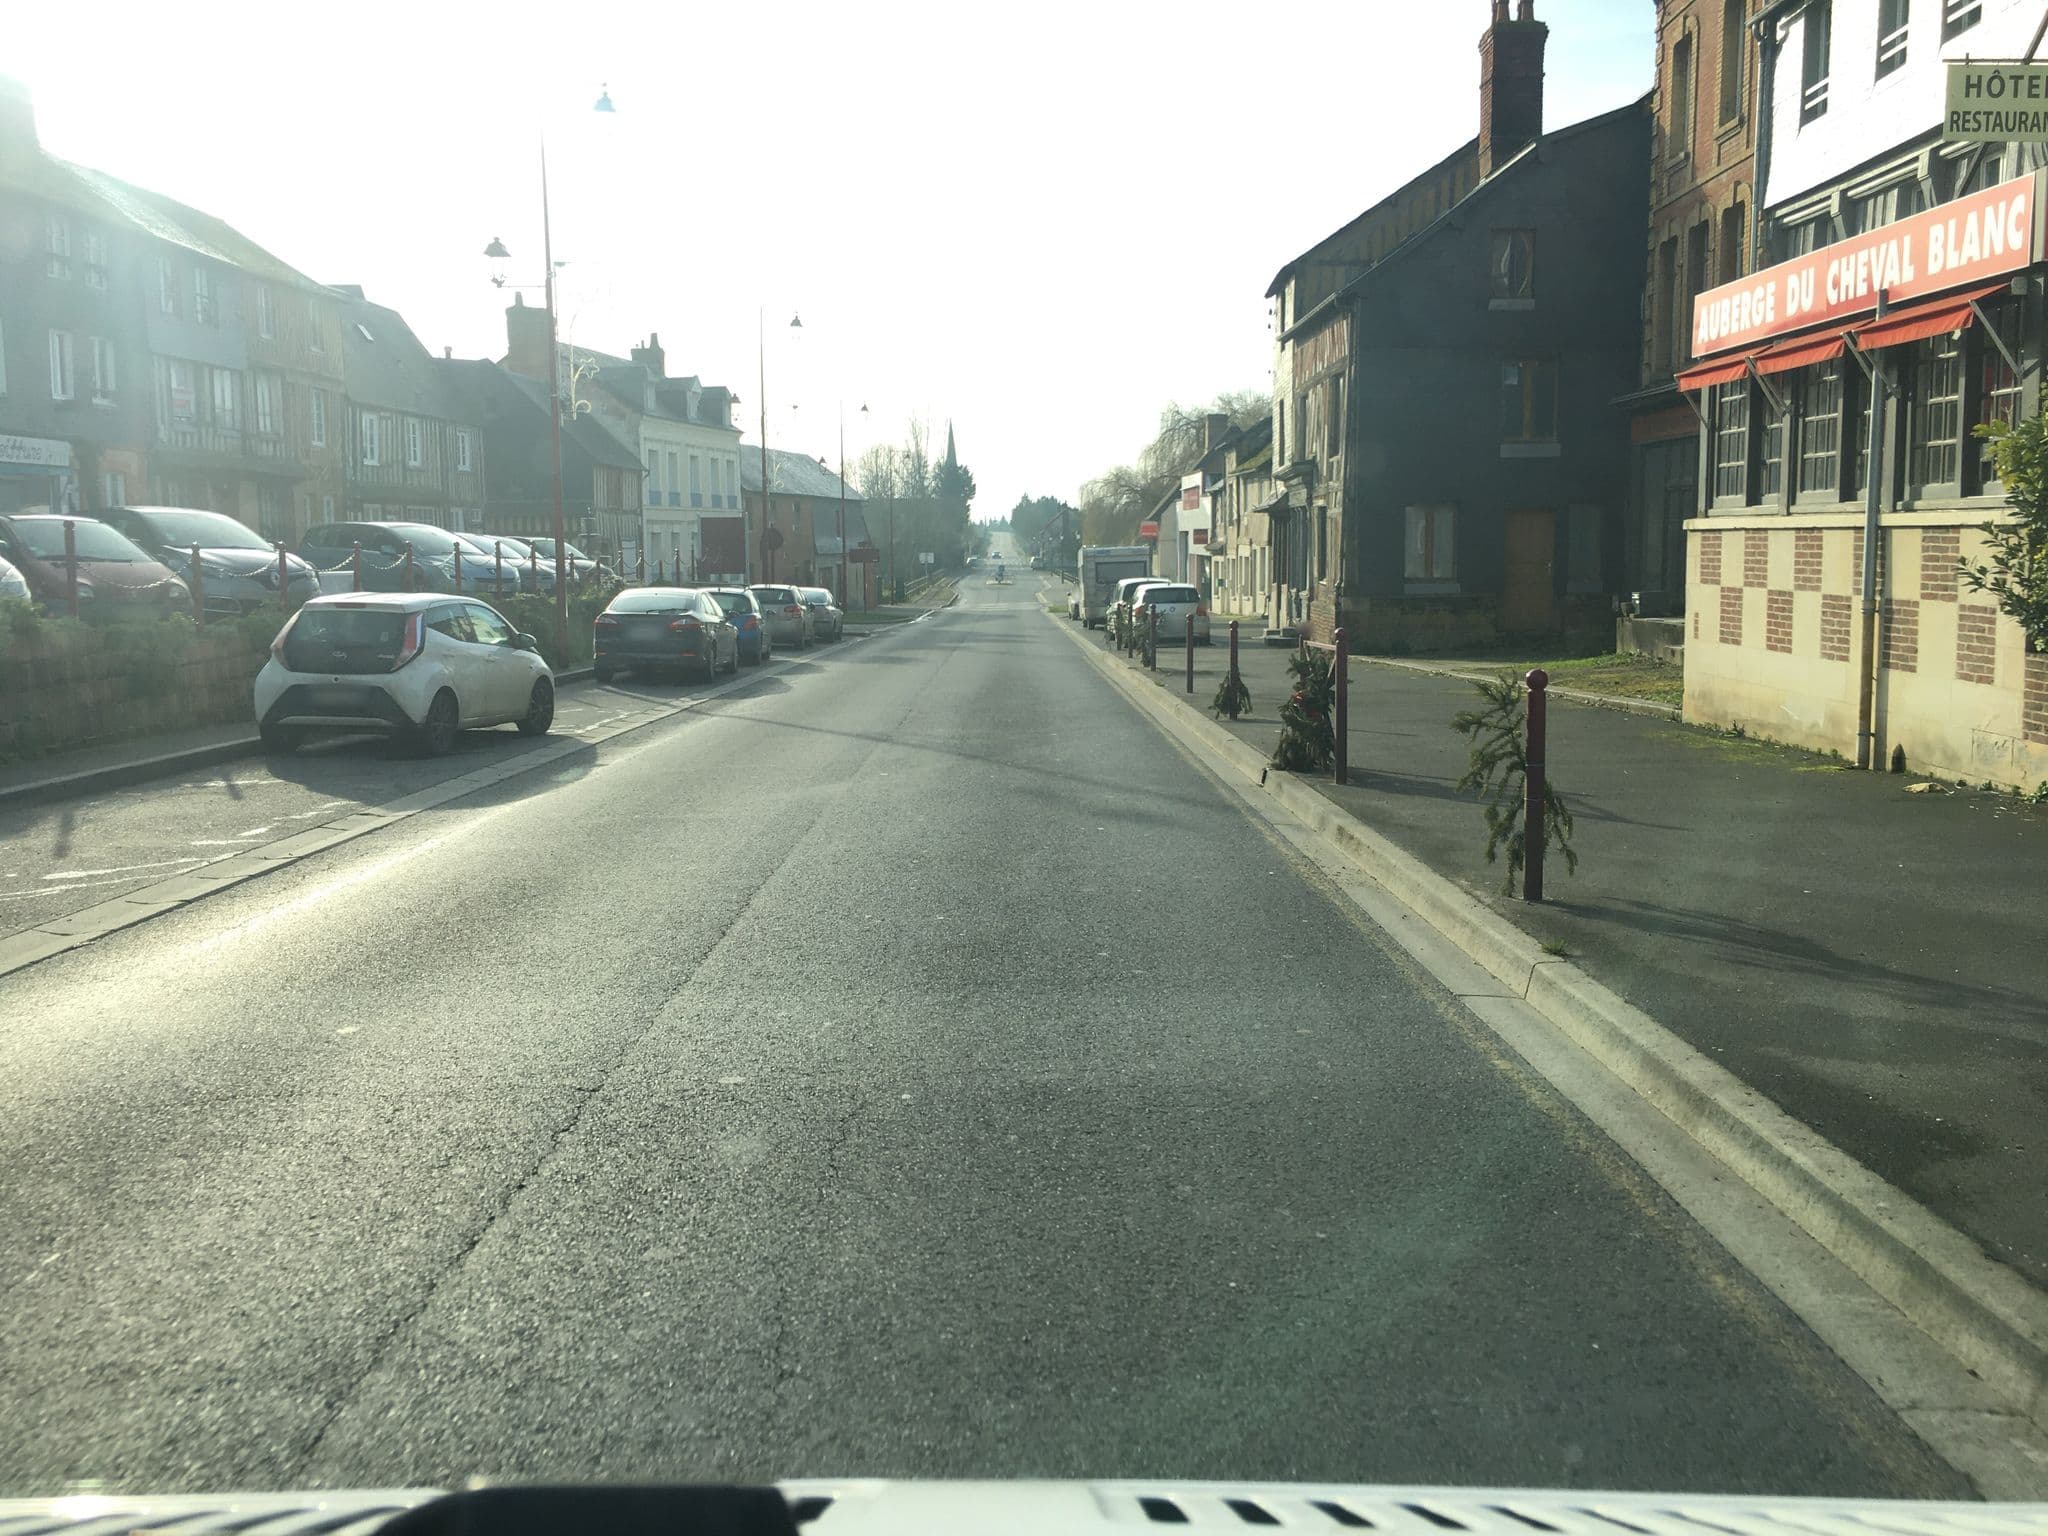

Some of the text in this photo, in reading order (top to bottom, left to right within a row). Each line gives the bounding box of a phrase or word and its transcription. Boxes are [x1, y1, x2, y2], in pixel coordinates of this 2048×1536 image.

[1964, 69, 2048, 99] HÔTE
[1697, 193, 2026, 345] AUBERGE DU CHEVAL BLANC
